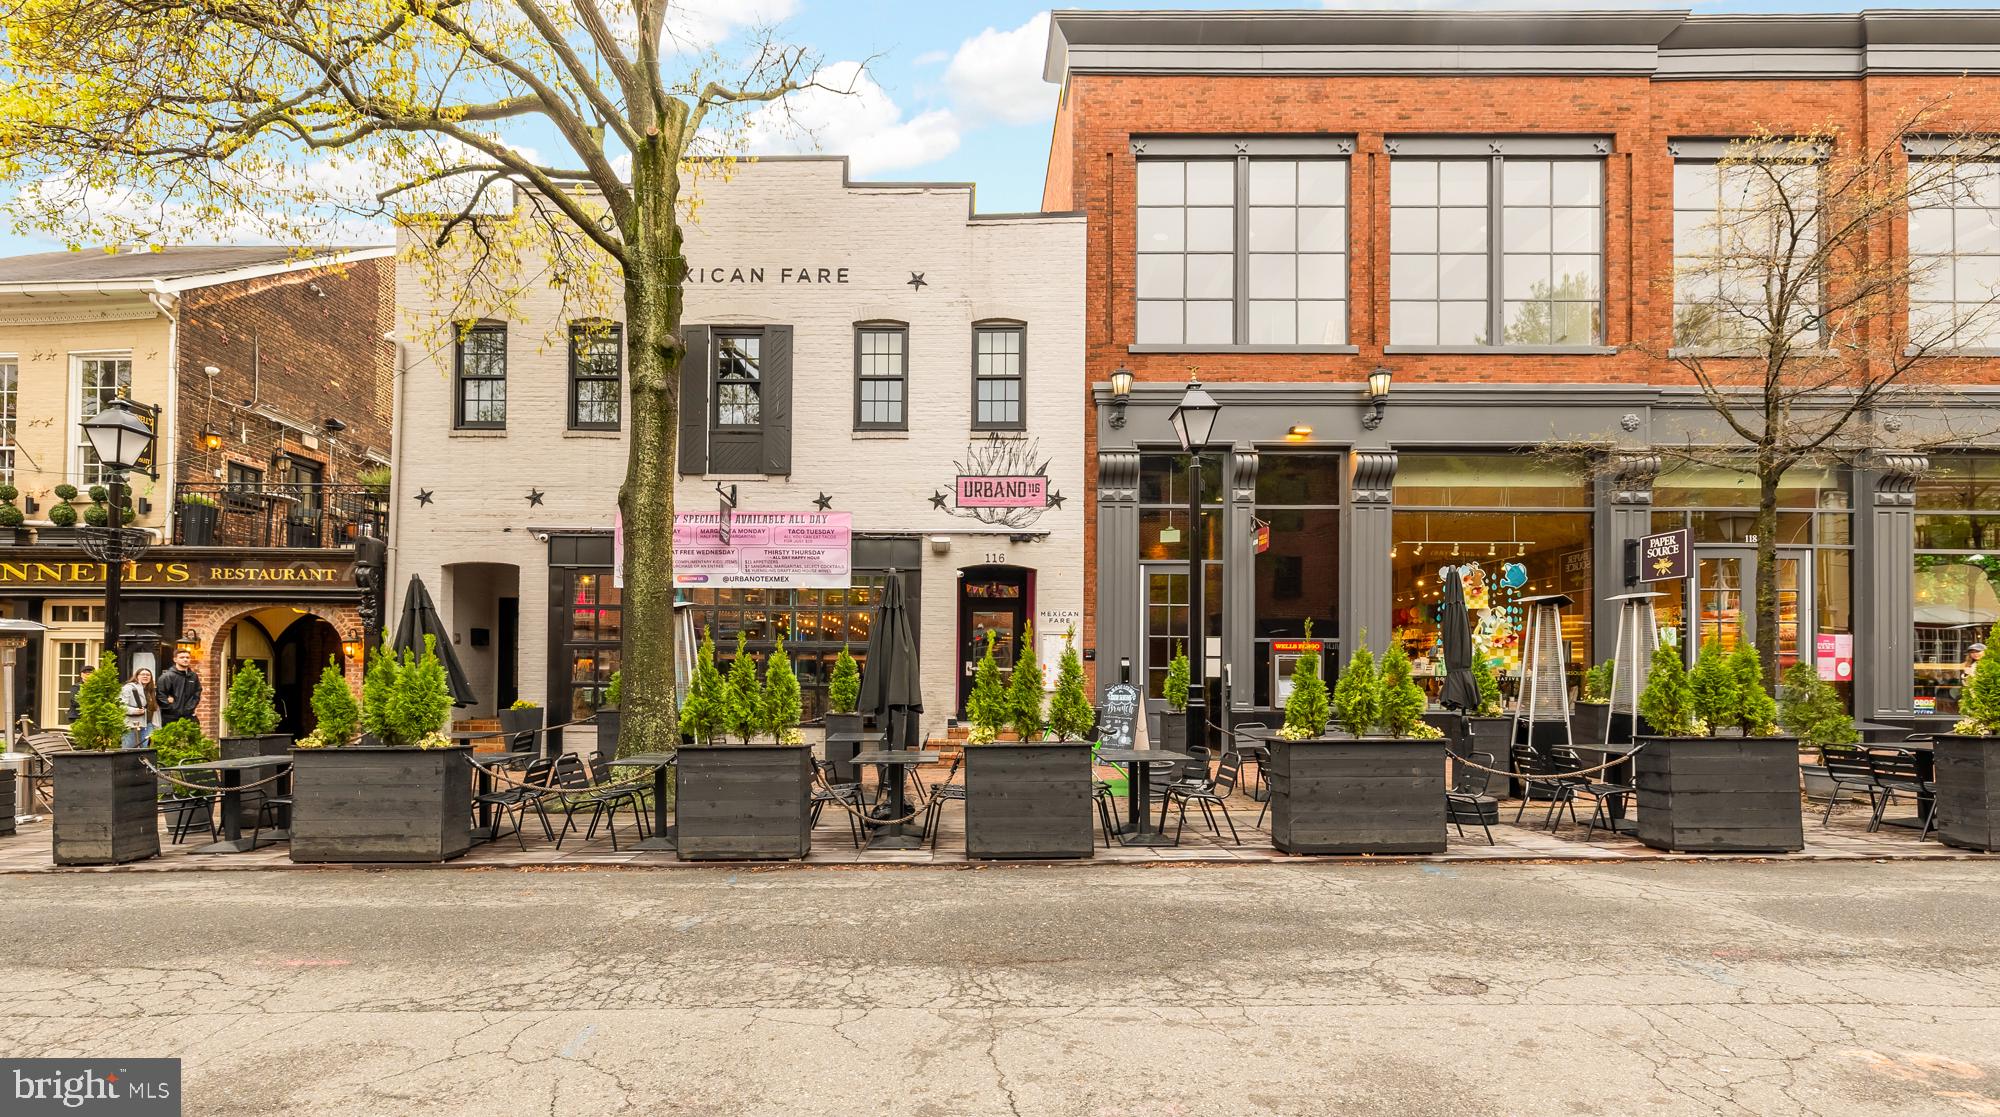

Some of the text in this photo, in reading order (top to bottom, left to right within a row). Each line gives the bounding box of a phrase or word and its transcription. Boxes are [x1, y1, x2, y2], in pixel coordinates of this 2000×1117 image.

[687, 268, 849, 283] XICAN FARE
[964, 481, 1040, 498] URBANO 116
[683, 514, 720, 524] SPECIAL
[736, 514, 786, 524] AVAILABLE
[789, 514, 806, 524] ALL
[810, 514, 828, 524] DAY
[1650, 536, 1676, 548] PAPER
[1745, 535, 1758, 543] 118
[1647, 544, 1680, 558] SOURCE
[985, 553, 1005, 563] 116
[210, 567, 337, 581] RESTAURANT
